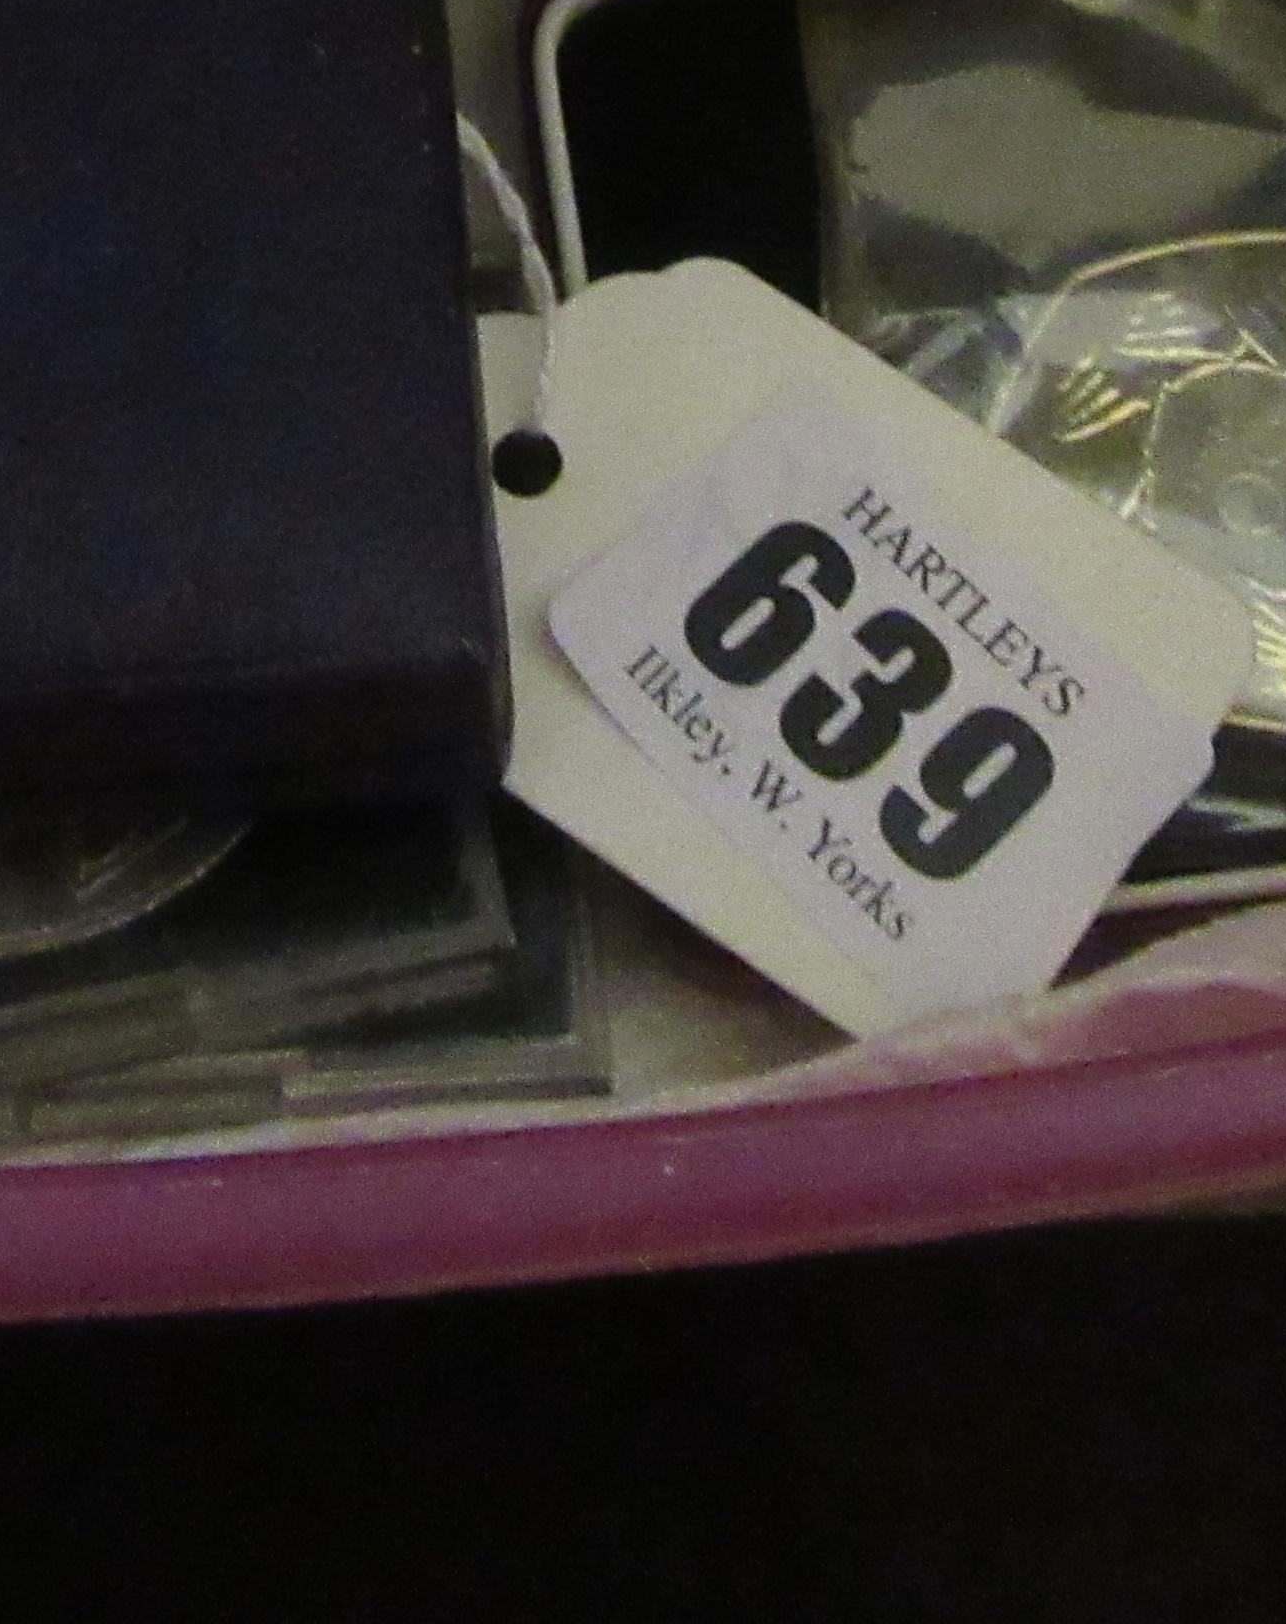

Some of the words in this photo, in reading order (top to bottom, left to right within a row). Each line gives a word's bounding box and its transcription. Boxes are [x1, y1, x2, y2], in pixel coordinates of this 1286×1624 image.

[684, 521, 1055, 880] 639
[843, 488, 1086, 717] HARTLEYS
[750, 760, 802, 831] W.
[808, 819, 913, 942] Yorks
